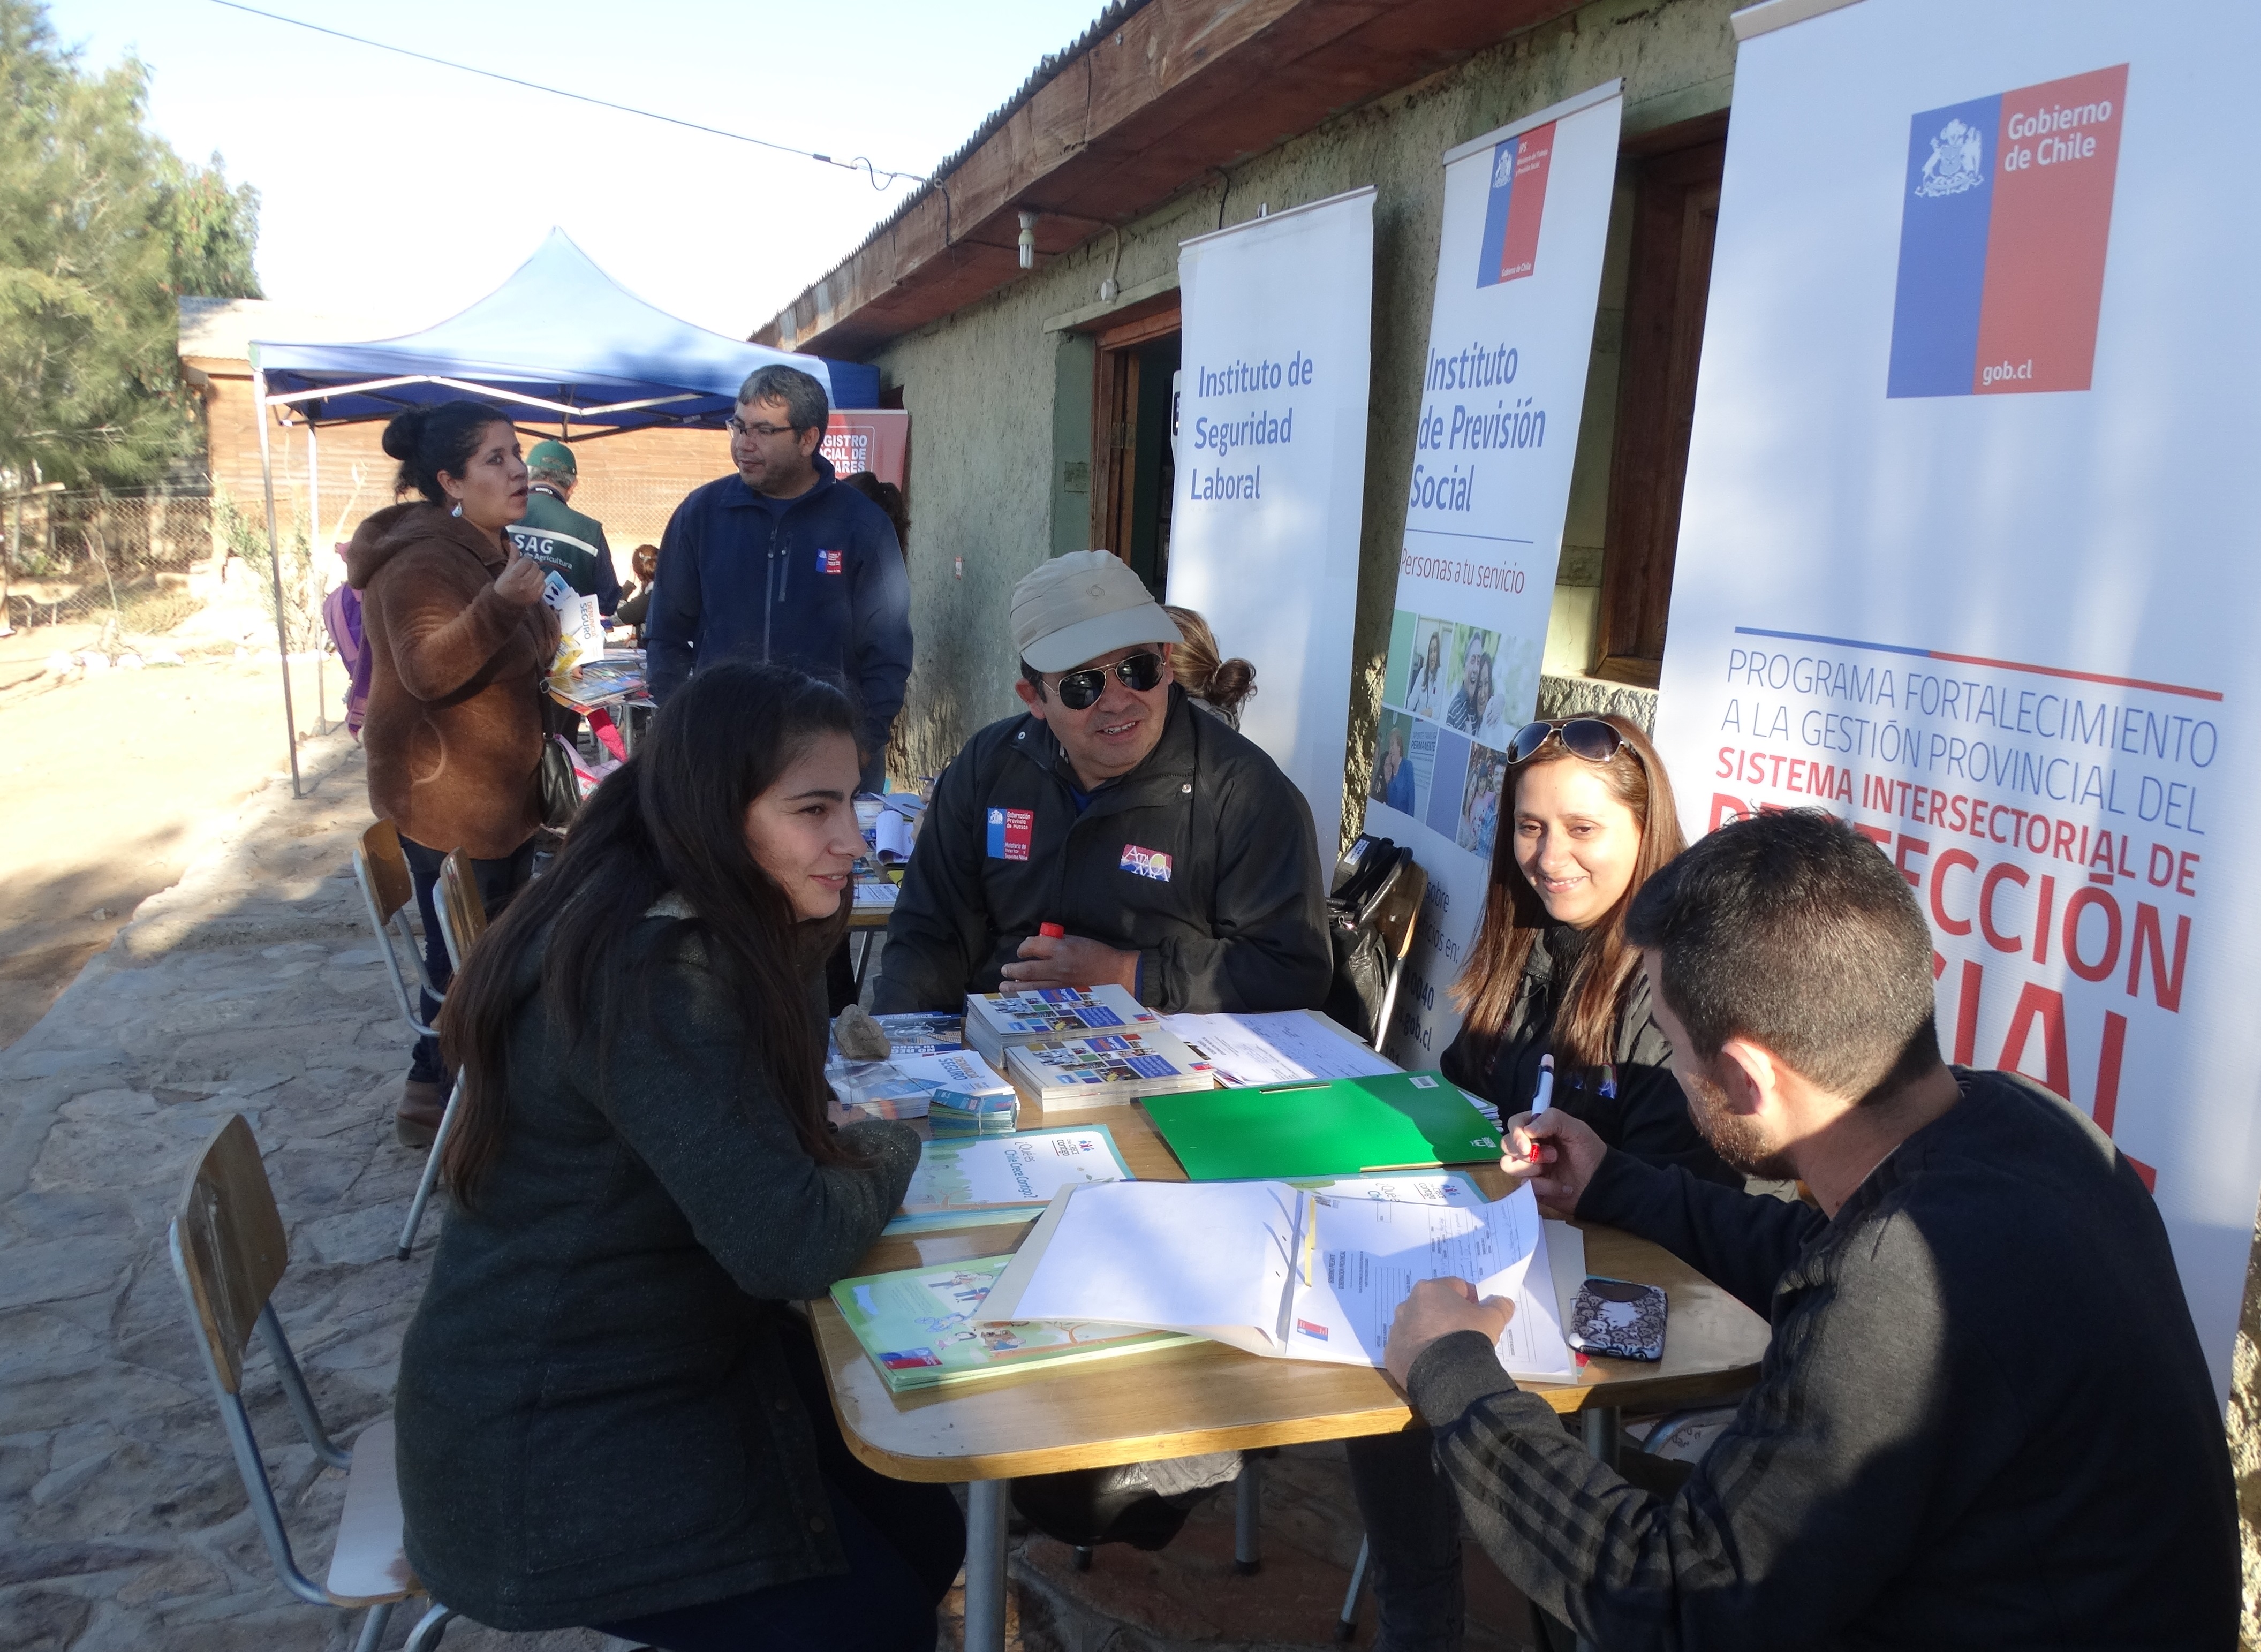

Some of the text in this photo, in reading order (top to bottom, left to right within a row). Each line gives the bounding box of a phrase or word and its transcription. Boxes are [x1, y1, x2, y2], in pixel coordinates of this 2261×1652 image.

[2007, 100, 2112, 141] Gobierno
[2005, 134, 2096, 172] de Chile
[1199, 350, 1313, 398] Instituto de
[1426, 342, 1518, 391] Instituto
[1982, 360, 2032, 385] gob.cl
[1194, 408, 1292, 457] Seguridad
[1419, 397, 1546, 450] de Previsión
[851, 448, 866, 460] DE
[1191, 465, 1260, 500] Laboral
[1410, 464, 1474, 512] Social
[514, 534, 554, 555] SAG
[535, 552, 573, 571] Agricultura
[1400, 547, 1525, 595] Personas a tu servicio
[580, 603, 592, 639] SEGURO
[587, 601, 598, 637] DENUNCIA
[1727, 649, 2218, 768] PROGRAMA FORTALECIMIENTO
[1721, 699, 2205, 835] A LA GESTIÓN PROVINCIAL DEL
[1715, 746, 2200, 897] SISTEMA INTERSECTORIAL DE
[1426, 881, 1450, 912] sobre
[1445, 938, 1460, 964] en:
[938, 1057, 969, 1080] SEGURO
[1010, 1163, 1024, 1176] Crece
[1016, 1176, 1039, 1198] Contigo?
